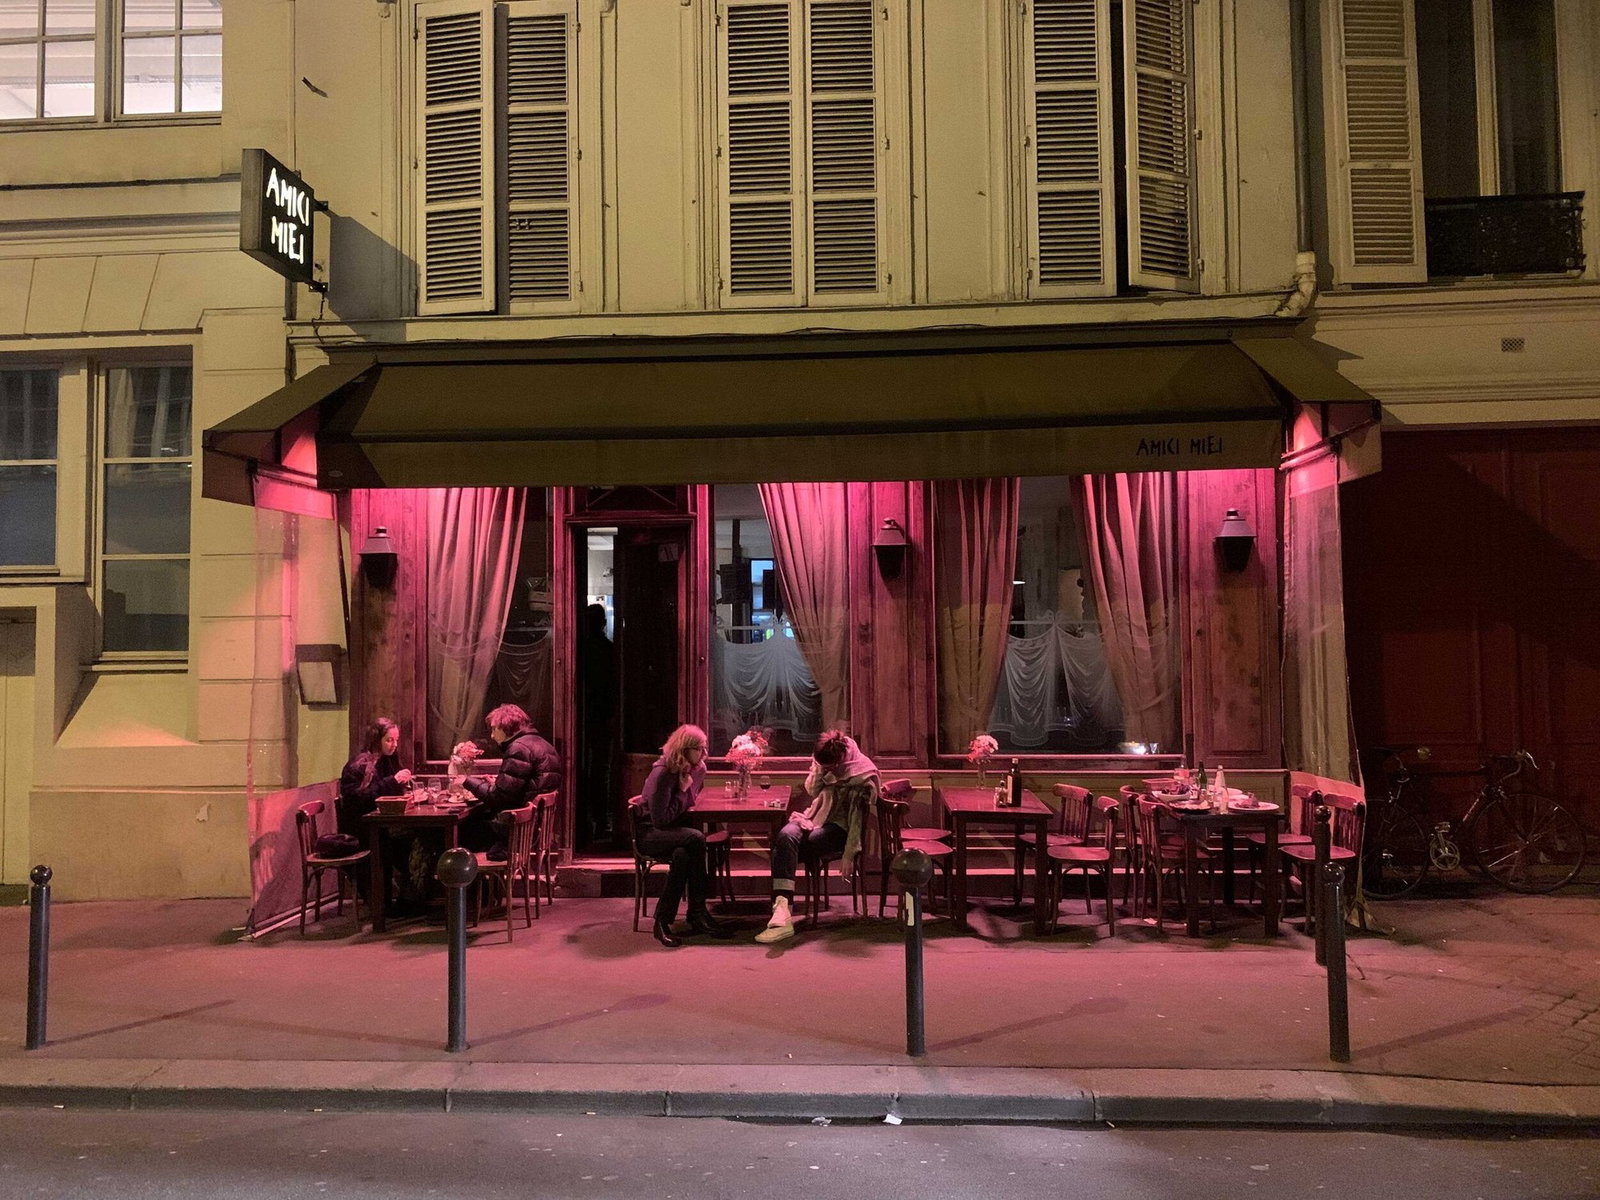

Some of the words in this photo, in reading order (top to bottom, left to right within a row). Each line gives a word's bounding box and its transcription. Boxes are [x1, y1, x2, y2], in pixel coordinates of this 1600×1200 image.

[266, 167, 310, 227] AMICI
[271, 215, 304, 264] MIEI
[1135, 437, 1180, 457] AMICI
[1189, 435, 1223, 456] MIEI
